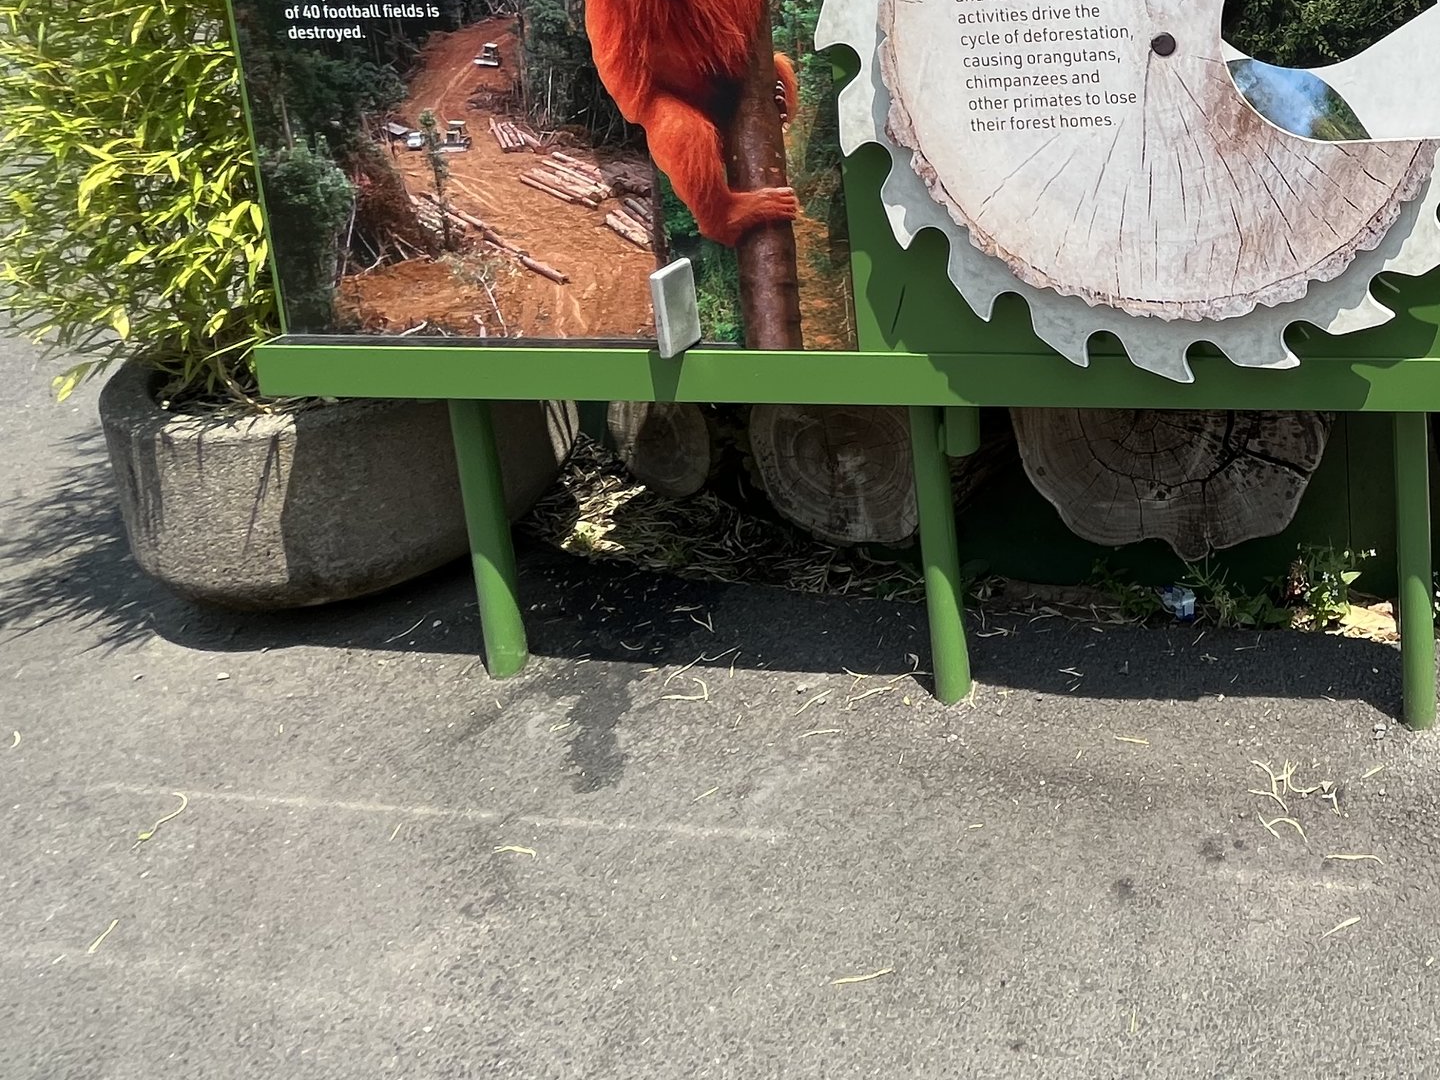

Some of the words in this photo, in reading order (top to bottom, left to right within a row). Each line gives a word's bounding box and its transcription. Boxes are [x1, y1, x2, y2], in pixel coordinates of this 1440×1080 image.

[285, 5, 300, 19] of
[302, 5, 320, 18] 40
[323, 4, 381, 18] football
[383, 4, 424, 18] fields
[426, 4, 440, 17] is
[958, 8, 1028, 24] activities
[1032, 6, 1071, 21] drive
[1075, 4, 1100, 18] the
[288, 25, 366, 42] destroyed.
[960, 31, 1000, 49] cycle
[1004, 29, 1019, 44] of
[1023, 25, 1134, 43] deforestation,
[963, 52, 1023, 70] causing
[1027, 49, 1121, 66] orangutans,
[966, 73, 1068, 91] chimpanzees
[1071, 69, 1100, 84] and
[968, 96, 1008, 111] other
[1013, 92, 1081, 112] primates
[1085, 91, 1101, 104] to
[1104, 89, 1137, 104] lose
[970, 117, 1006, 132] their
[1010, 115, 1056, 130] forest
[1060, 113, 1117, 128] homes.
